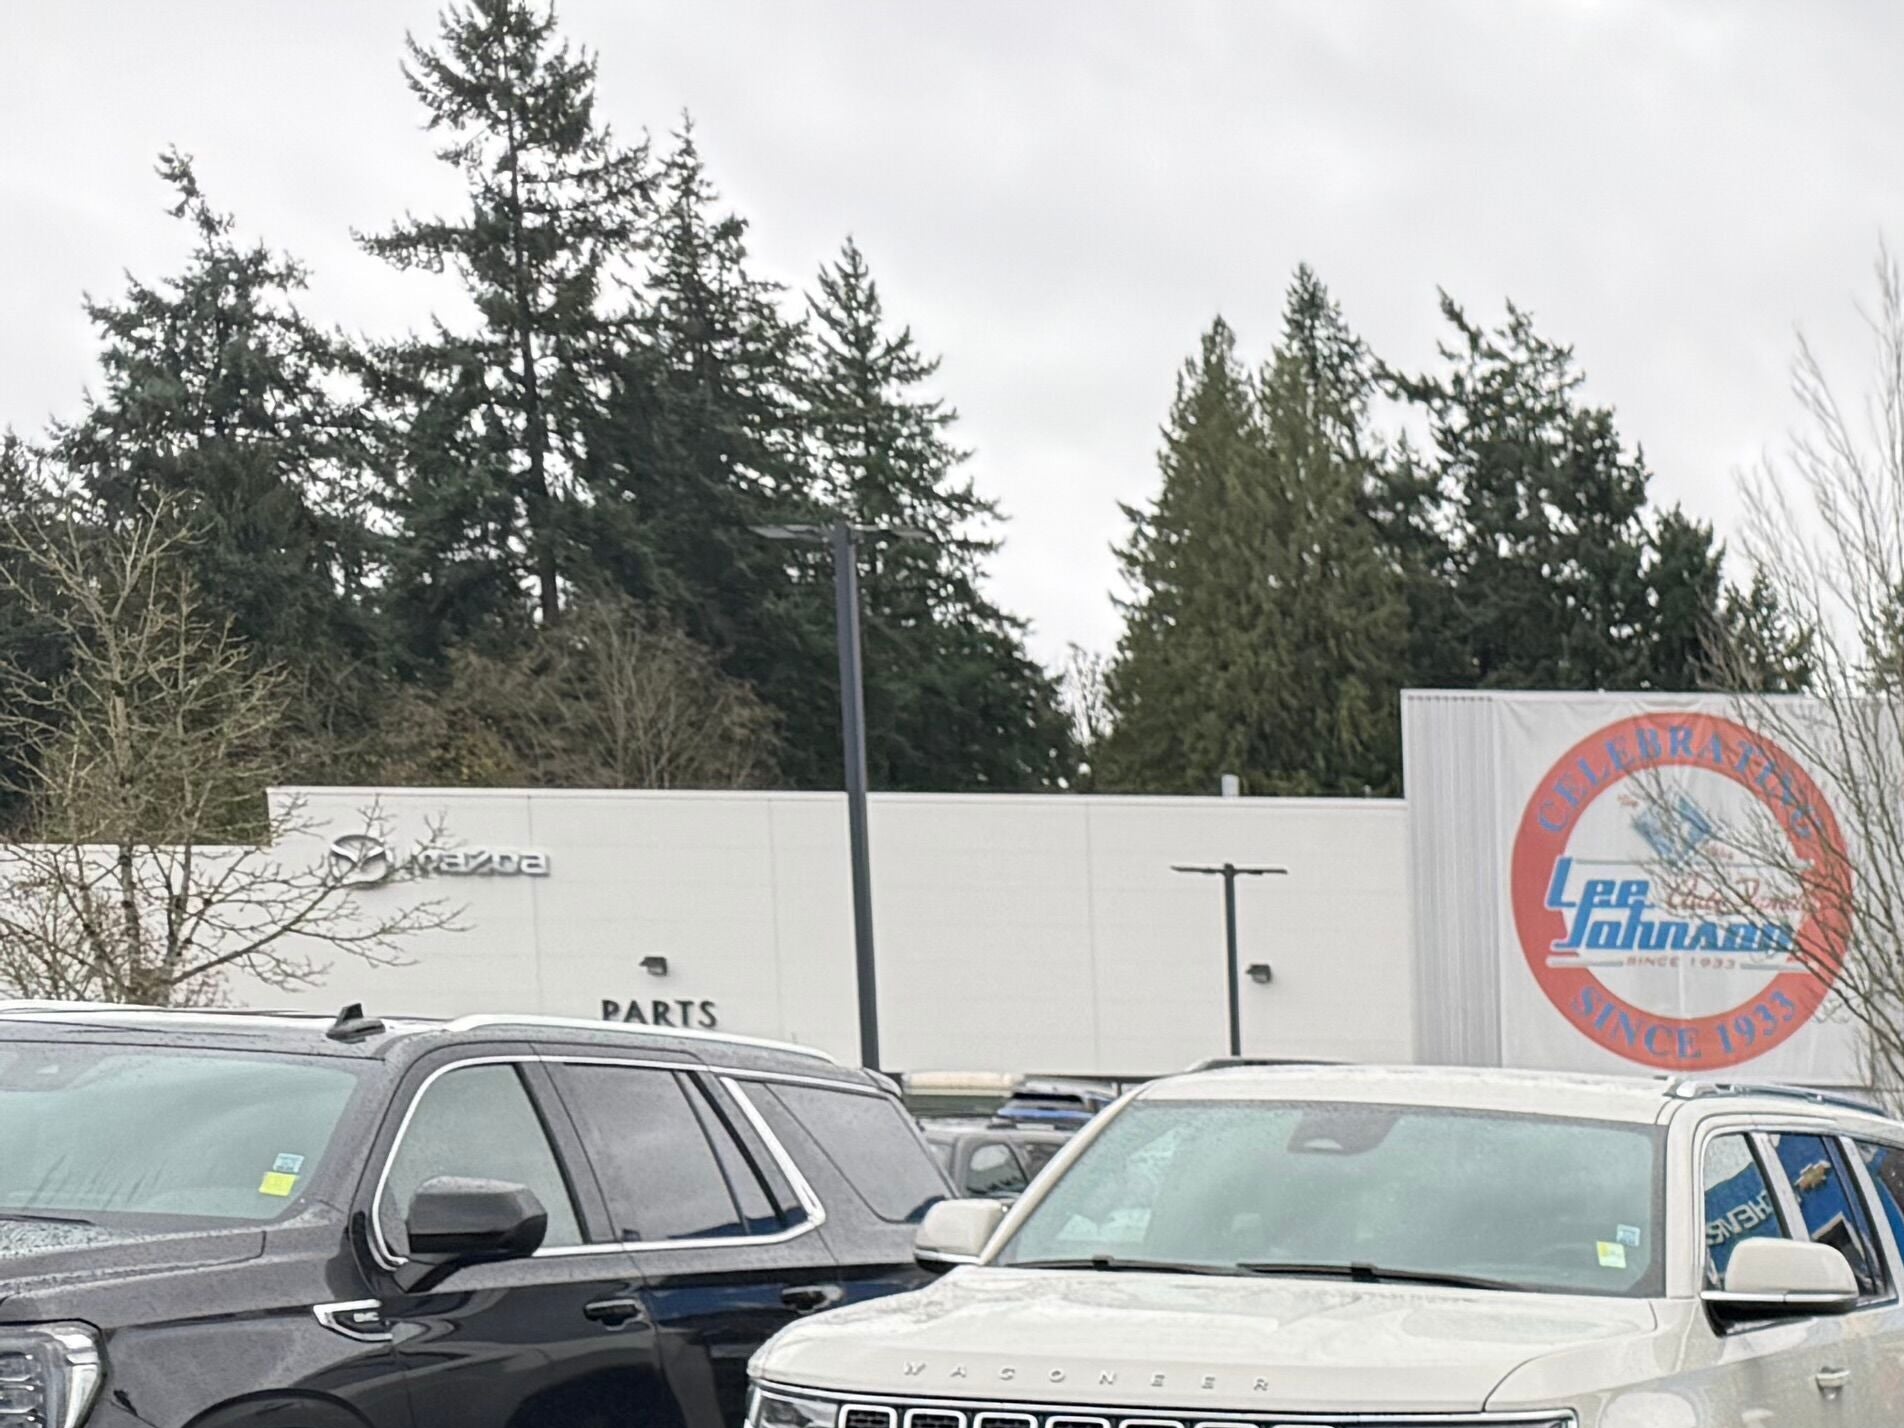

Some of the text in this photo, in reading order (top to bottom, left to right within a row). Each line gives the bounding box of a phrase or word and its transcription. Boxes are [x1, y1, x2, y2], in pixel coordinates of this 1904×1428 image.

[1537, 725, 1822, 840] CELEBRATING
[1546, 857, 1655, 908] Lee
[1551, 904, 1798, 951] Johnson
[1626, 956, 1737, 969] SINCE 1933
[601, 999, 718, 1029] PARTS
[1571, 985, 1797, 1059] SINCE 1933
[903, 1360, 1270, 1392] WAGONEER
